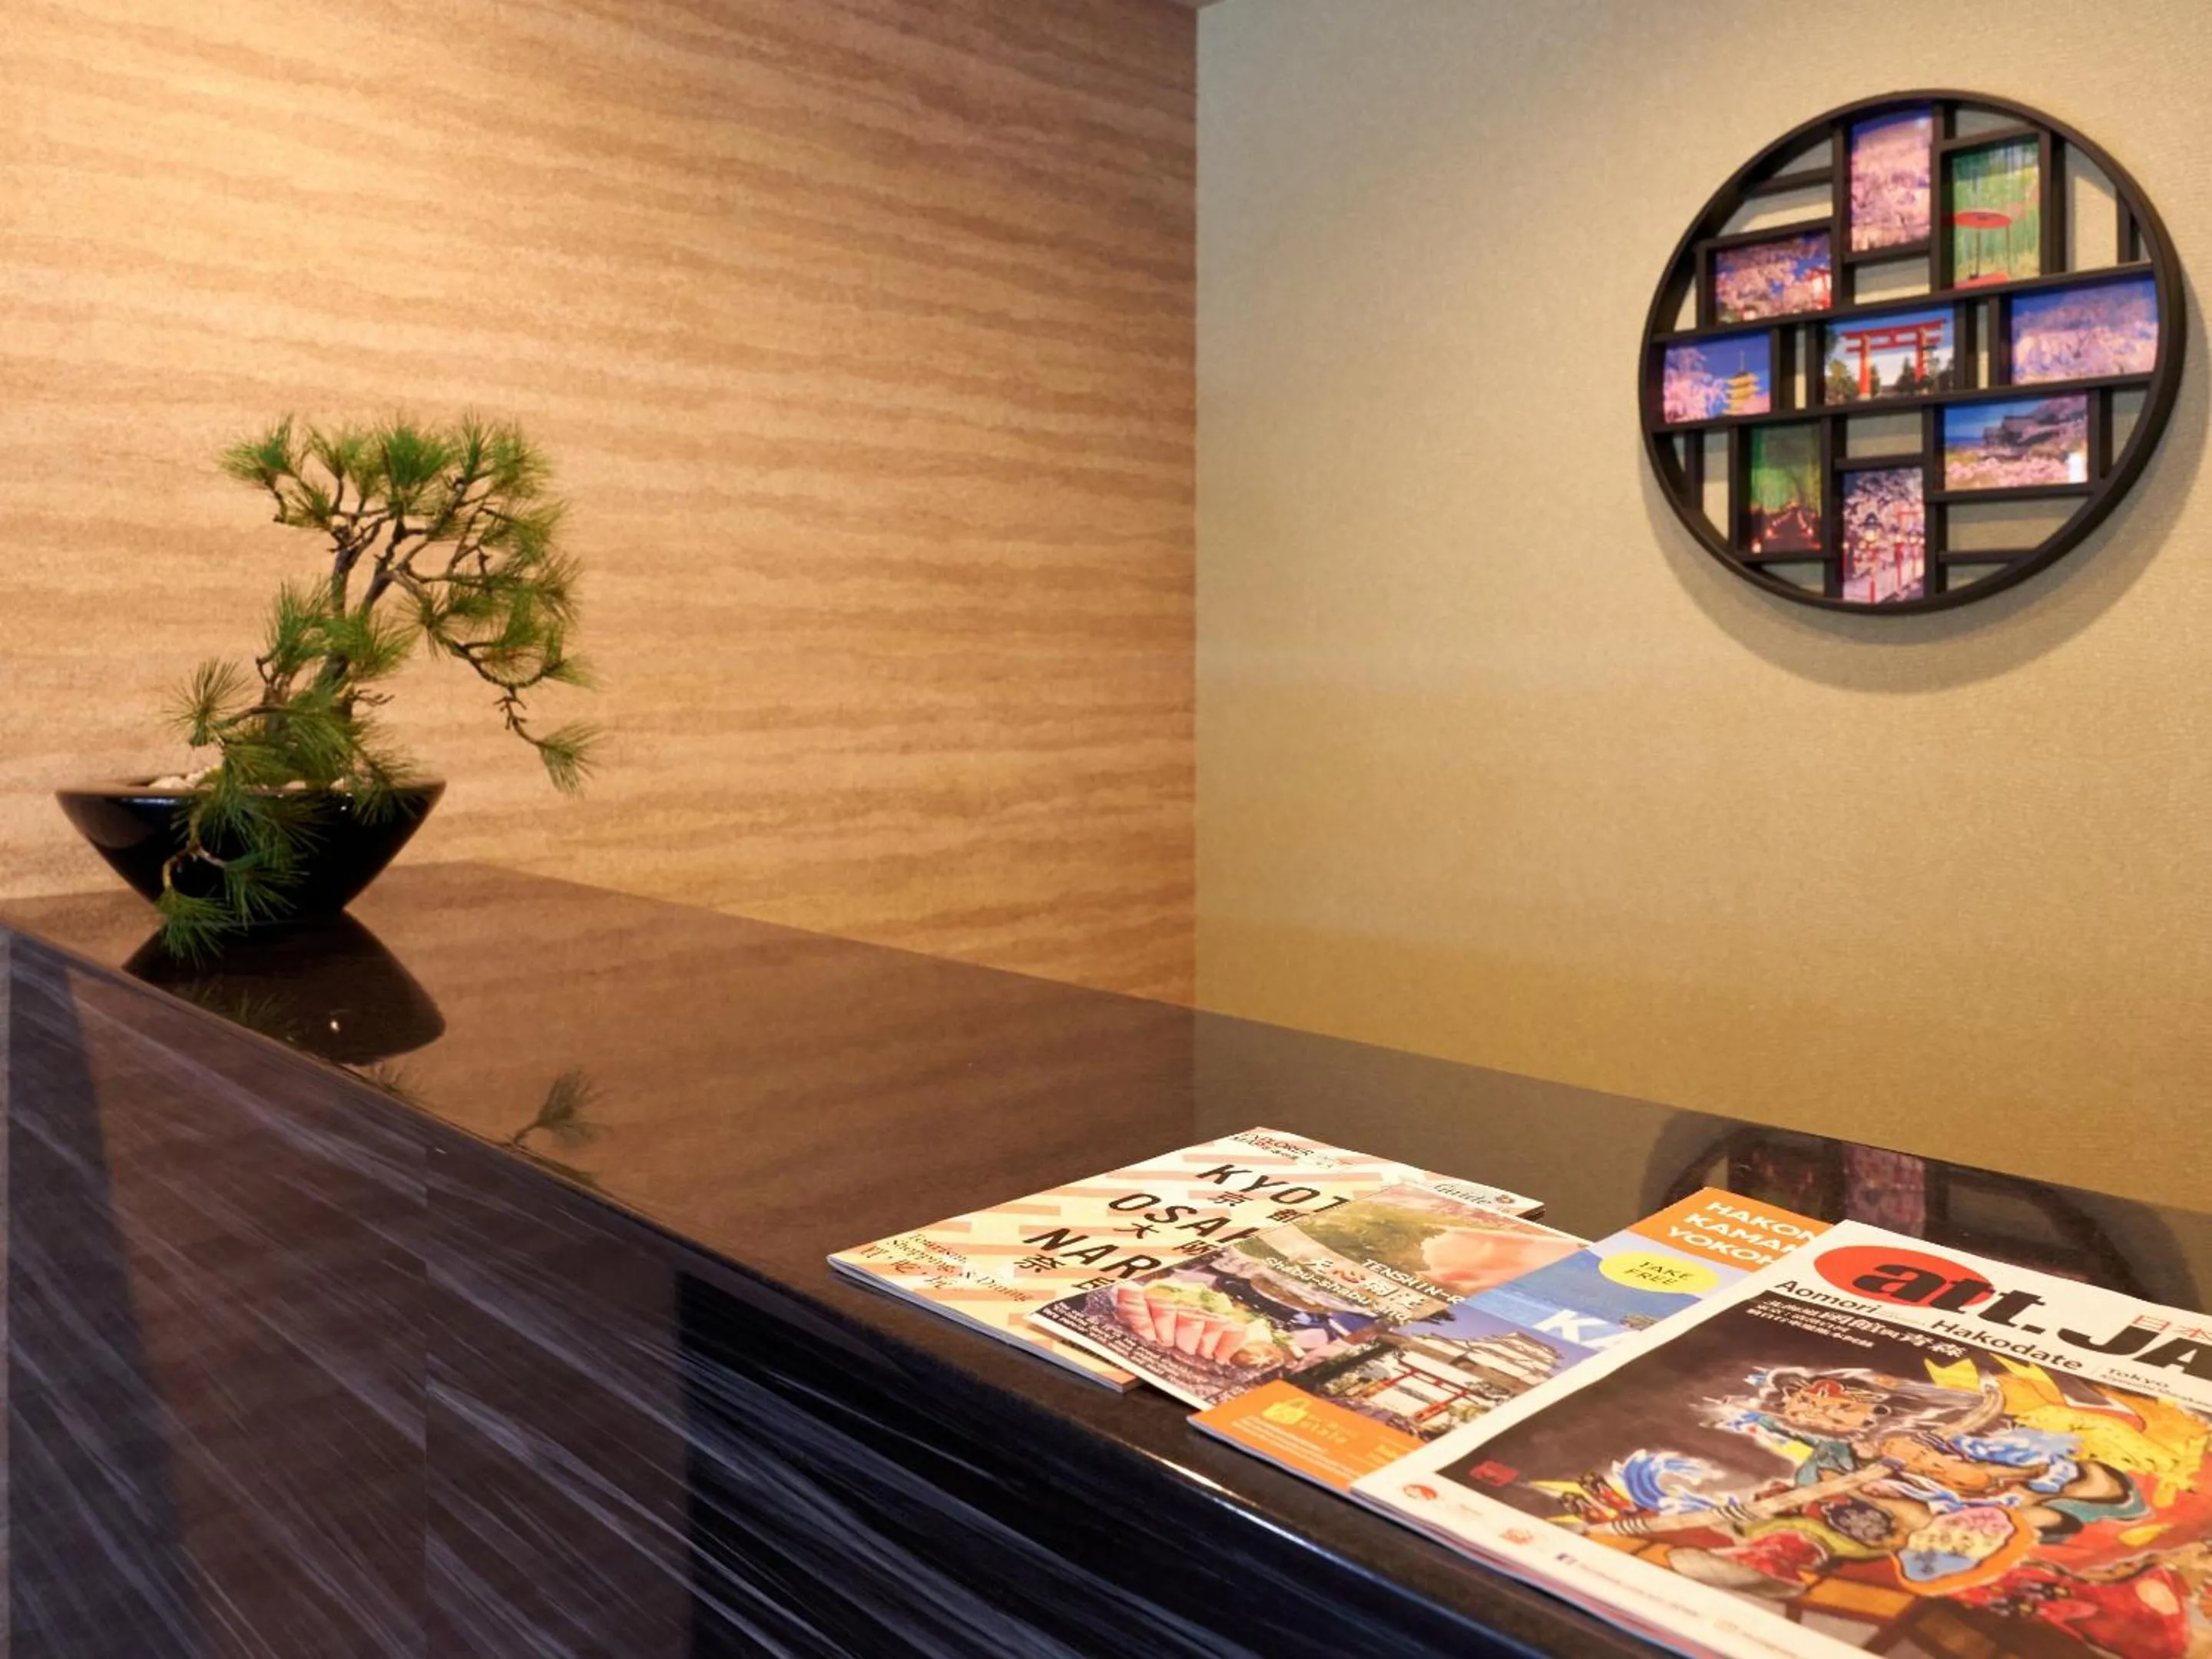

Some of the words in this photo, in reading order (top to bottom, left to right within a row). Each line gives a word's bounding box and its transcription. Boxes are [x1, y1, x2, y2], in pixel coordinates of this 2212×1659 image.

[1624, 1268, 1677, 1286] FREE
[1638, 1260, 1694, 1280] TAKE
[1774, 1280, 1882, 1314] Aomori
[1930, 1320, 2084, 1371] Hakodate
